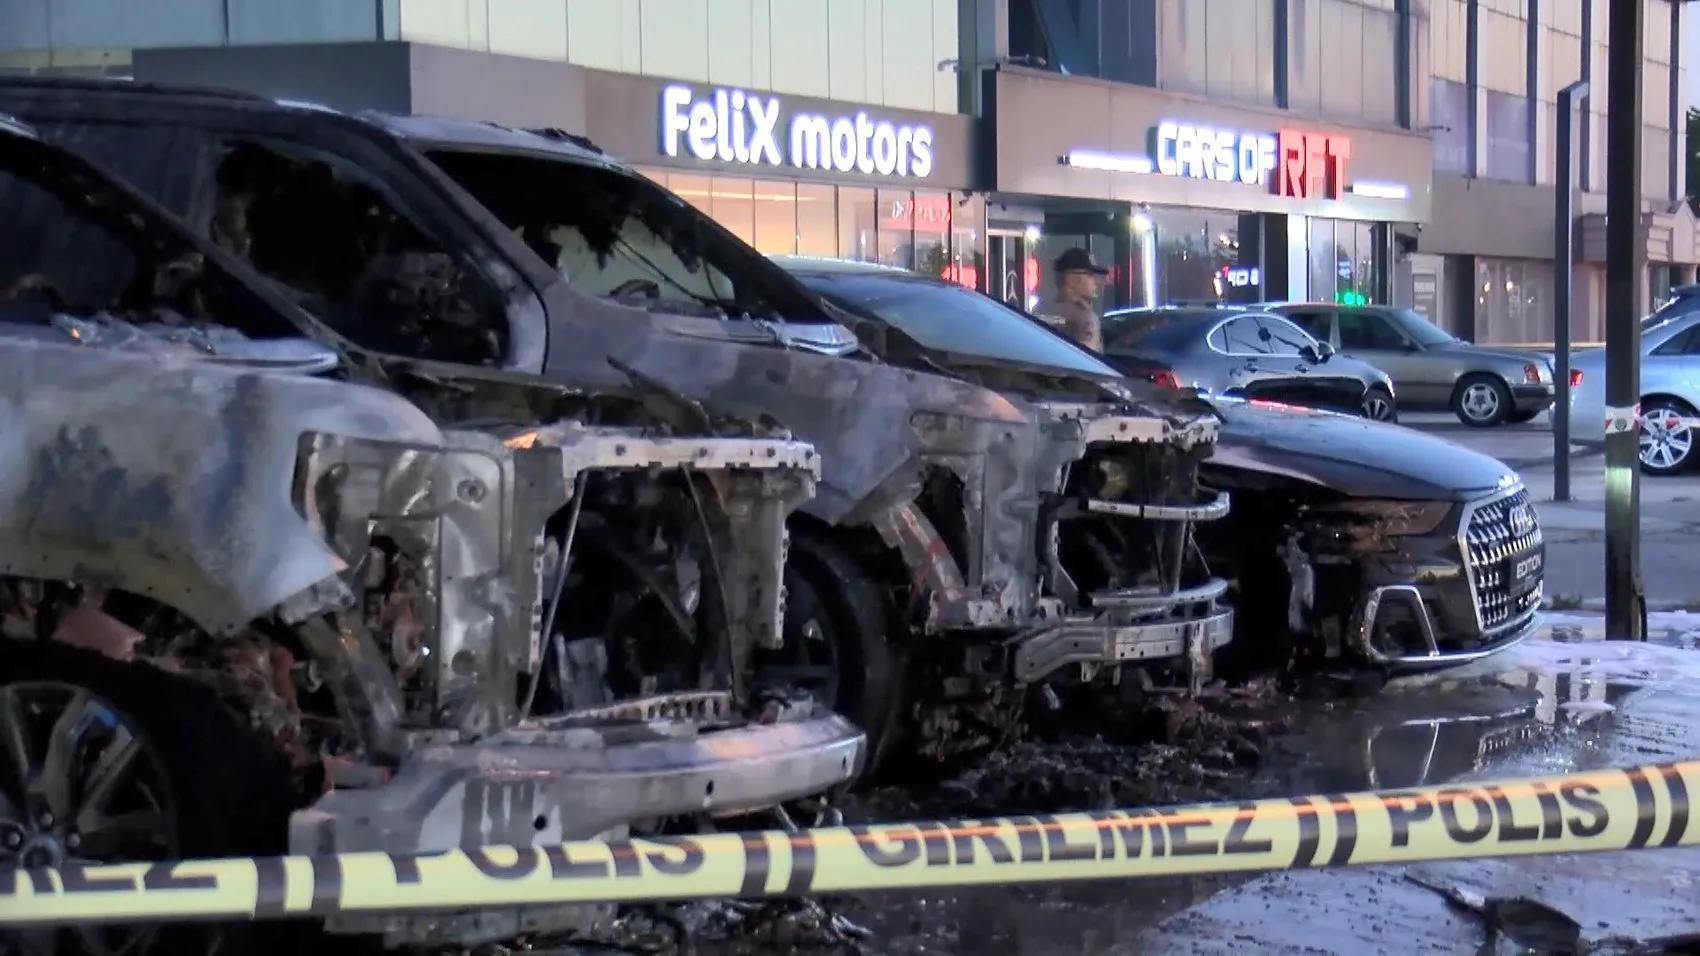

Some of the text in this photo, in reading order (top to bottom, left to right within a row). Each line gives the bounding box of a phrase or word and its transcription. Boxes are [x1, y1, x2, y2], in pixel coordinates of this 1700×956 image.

[661, 84, 934, 179] FeliX motors
[1155, 119, 1353, 203] CARS OF RFT
